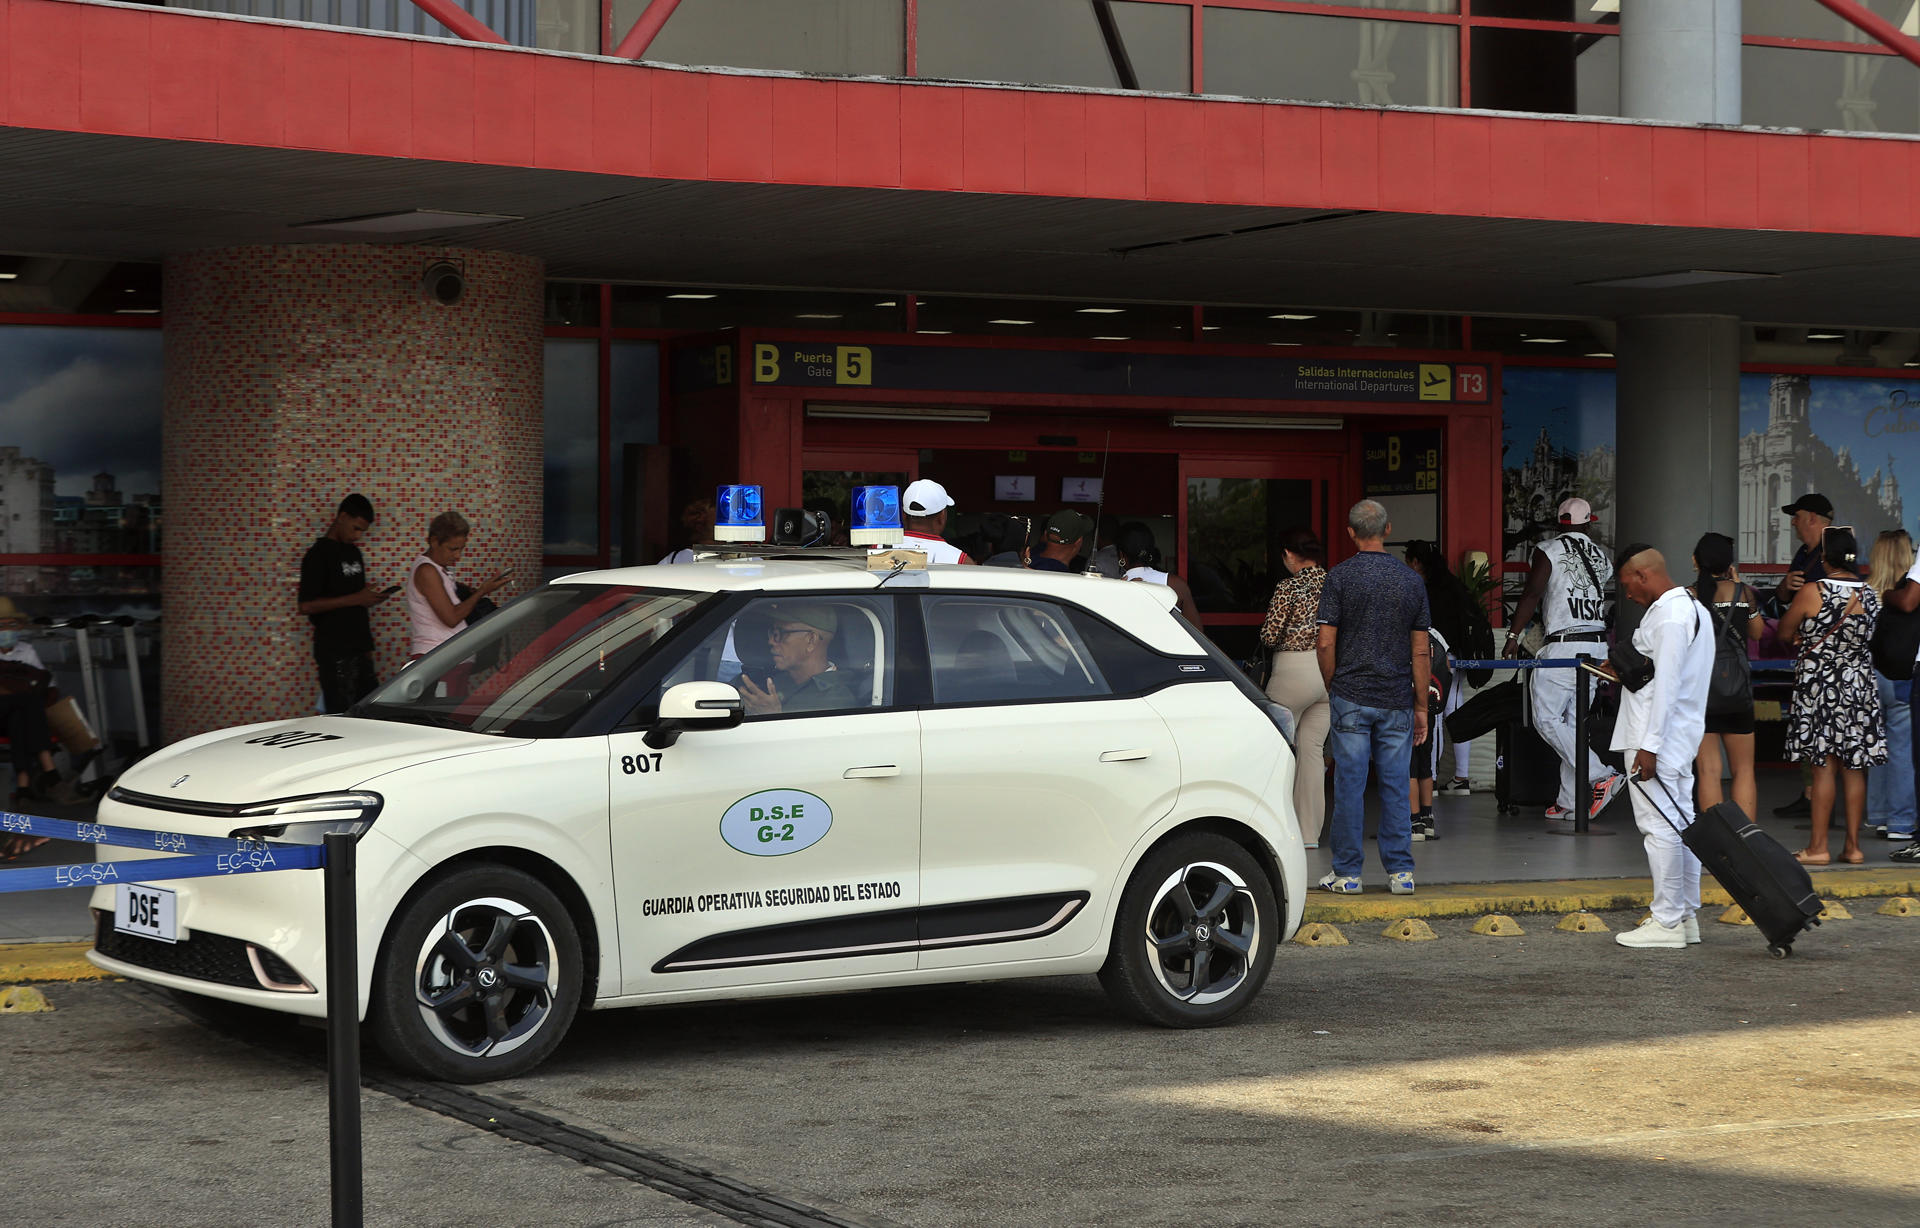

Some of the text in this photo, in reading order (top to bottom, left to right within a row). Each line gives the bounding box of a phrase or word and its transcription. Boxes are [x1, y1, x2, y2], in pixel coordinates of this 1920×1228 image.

[755, 343, 780, 383] B
[794, 352, 832, 364] Puerta
[846, 353, 861, 379] 5
[807, 365, 832, 377] Gate
[1298, 366, 1414, 380] Salidas Internacionales
[1295, 378, 1414, 394] International Departures
[1459, 373, 1483, 394] T3
[1387, 436, 1400, 471] B
[244, 731, 344, 748] 807
[621, 753, 662, 775] 807
[750, 804, 804, 822] D.S.E
[757, 824, 794, 843] G-2
[643, 881, 901, 917] GUARDIA OPERATIVA SEGURIDAD DEL ESTADO
[130, 892, 159, 928] DSE
